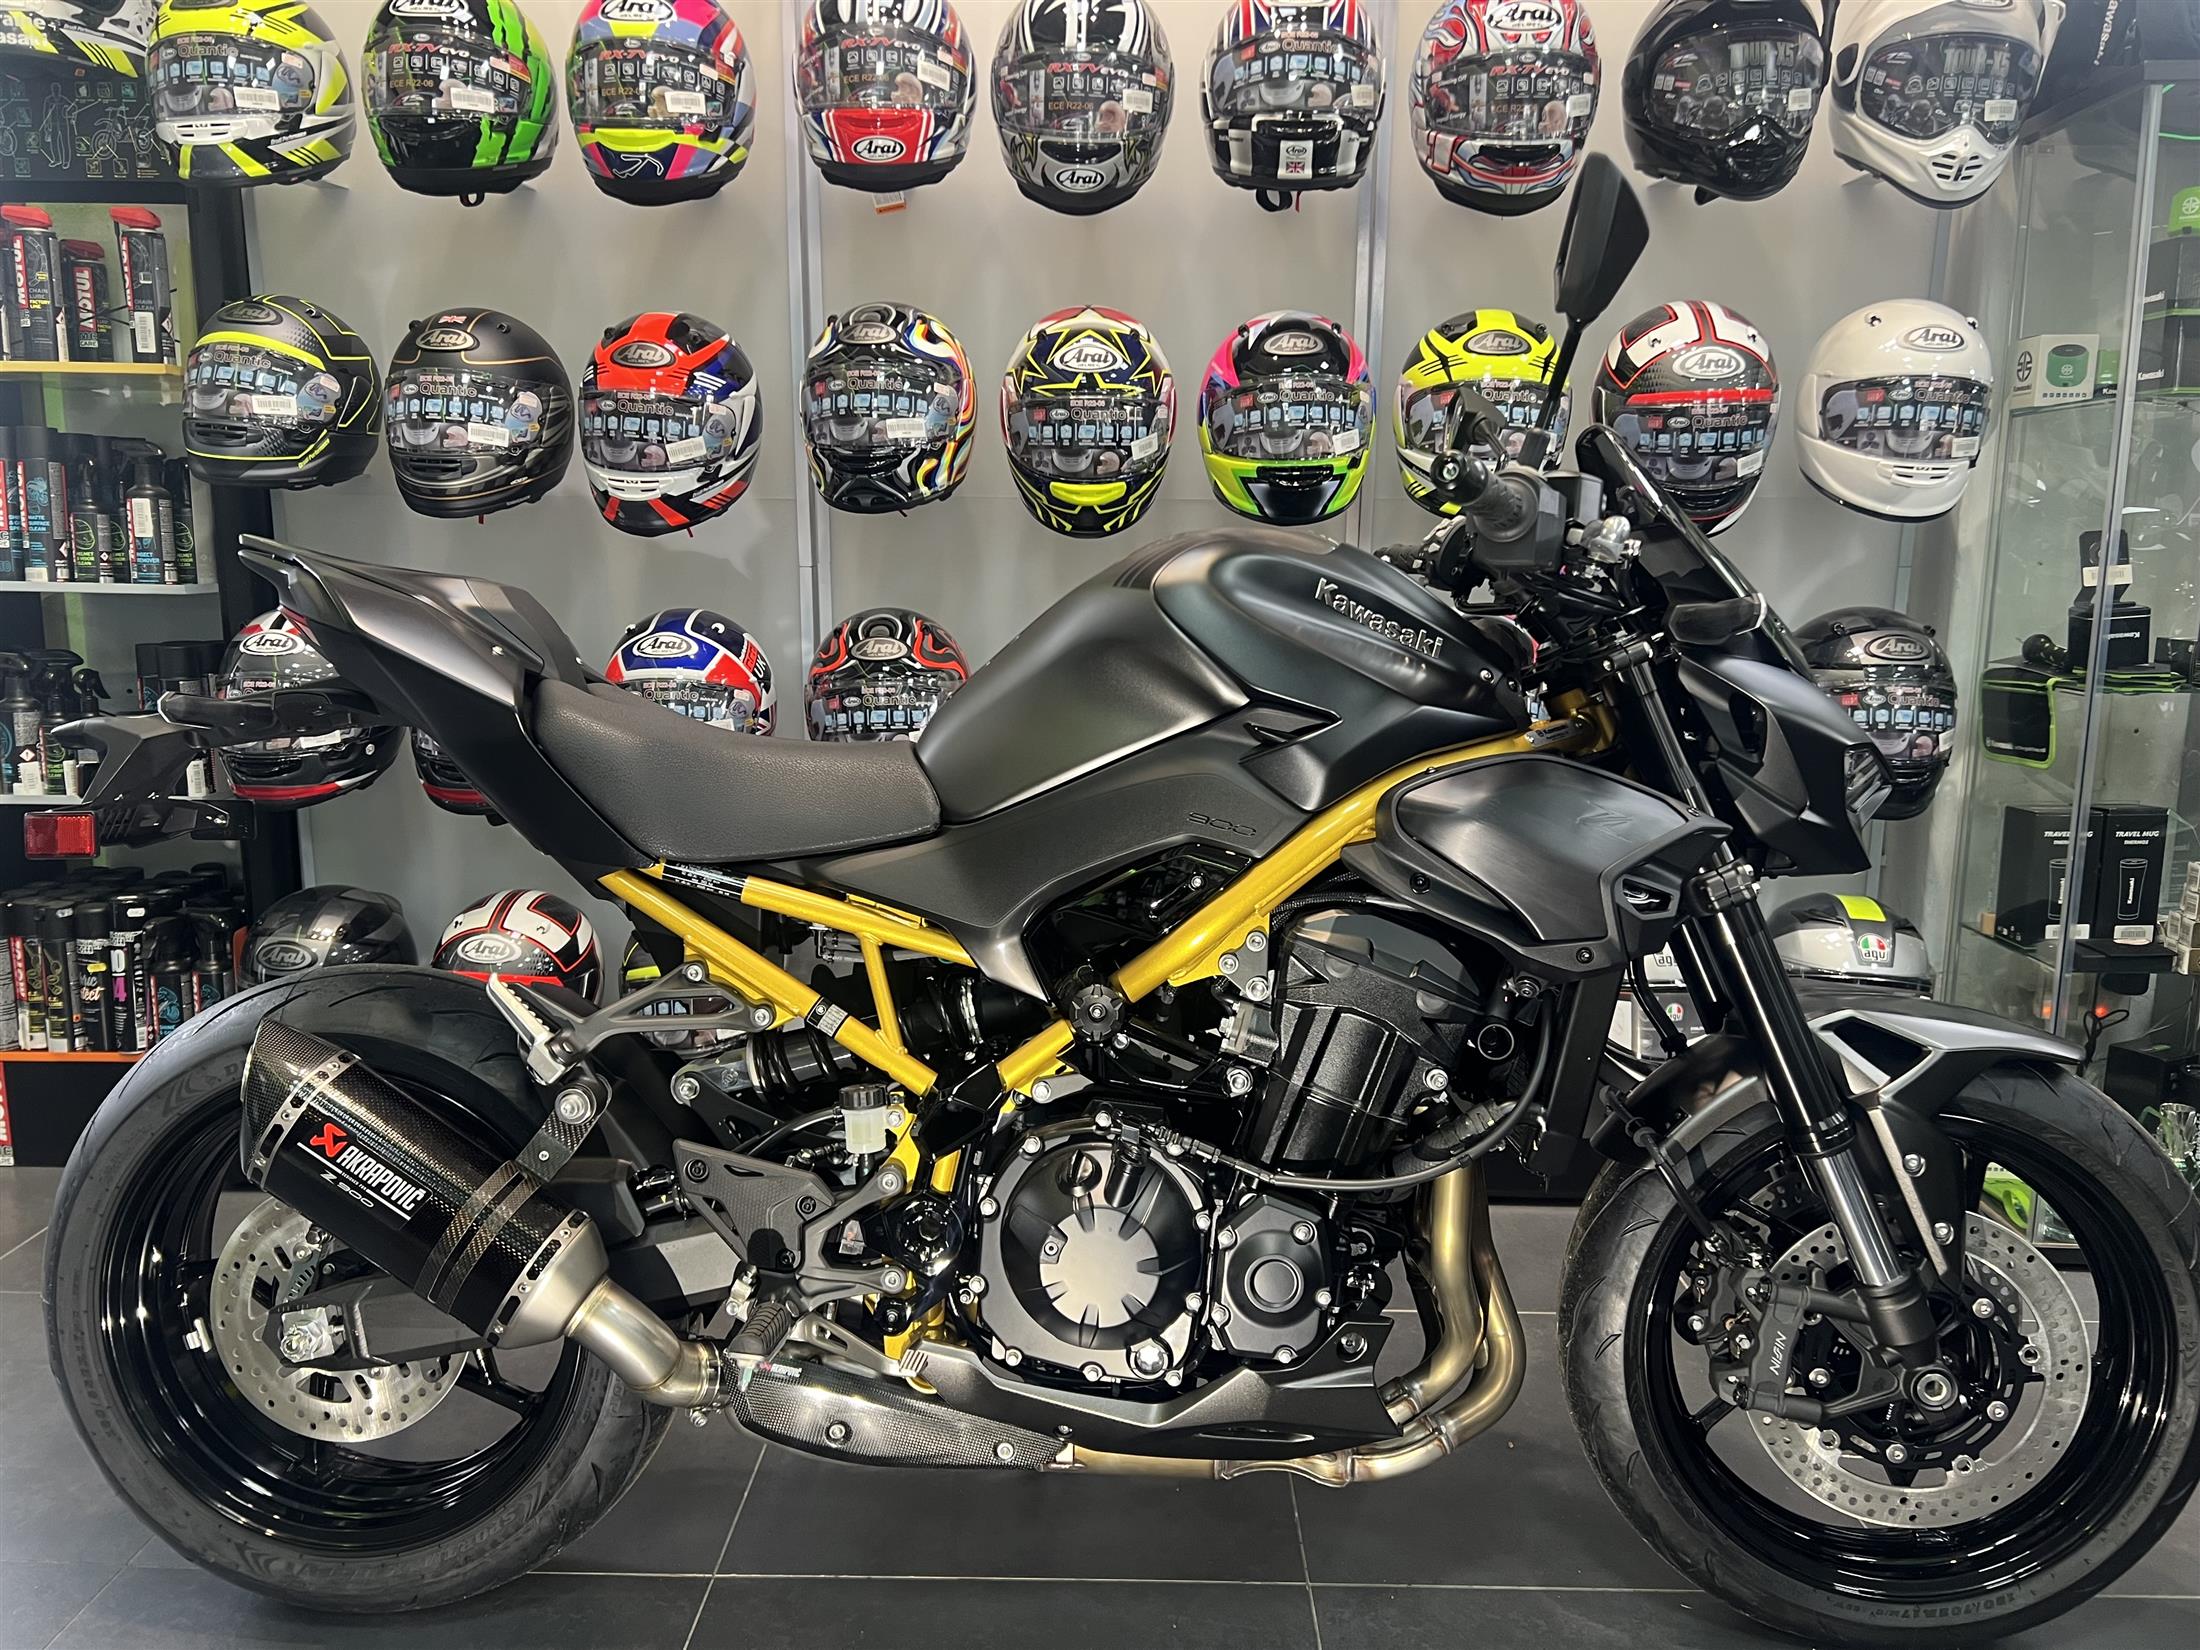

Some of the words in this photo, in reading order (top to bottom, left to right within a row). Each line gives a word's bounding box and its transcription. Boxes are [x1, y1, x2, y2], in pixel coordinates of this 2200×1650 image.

[1492, 8, 1560, 25] Arai
[857, 141, 899, 155] Arai
[1058, 171, 1099, 185] Arai
[76, 270, 95, 329] MOTUL
[422, 330, 466, 344] Arai
[848, 323, 891, 337] Arai
[1909, 328, 1958, 344] Arai
[1271, 335, 1317, 349] Arai
[1473, 334, 1521, 348] Arai
[213, 351, 271, 368] Quantic
[619, 344, 664, 361] Arai
[1062, 349, 1112, 364] Arai
[1684, 354, 1733, 369] Arai
[419, 382, 478, 398] Quantic
[847, 376, 904, 391] Quantic
[1279, 389, 1336, 402] Quantic
[1482, 389, 1537, 403] Quantic
[617, 400, 675, 416] Quantic
[1071, 407, 1127, 422] Quantic
[1691, 414, 1748, 428] Quantic
[1314, 577, 1444, 659] Kawasaki
[246, 634, 291, 648] Arai
[641, 637, 686, 650] Arai
[859, 640, 903, 655] Arai
[1881, 638, 1923, 653] Arai
[643, 689, 700, 701] Quantic
[862, 694, 917, 708] Quantic
[1186, 811, 1257, 837] 900
[263, 947, 304, 964] Arai
[467, 940, 507, 956] Arai
[335, 1146, 427, 1212] AKRAPOVIČ
[319, 1170, 337, 1185] Z
[337, 1182, 375, 1209] 900
